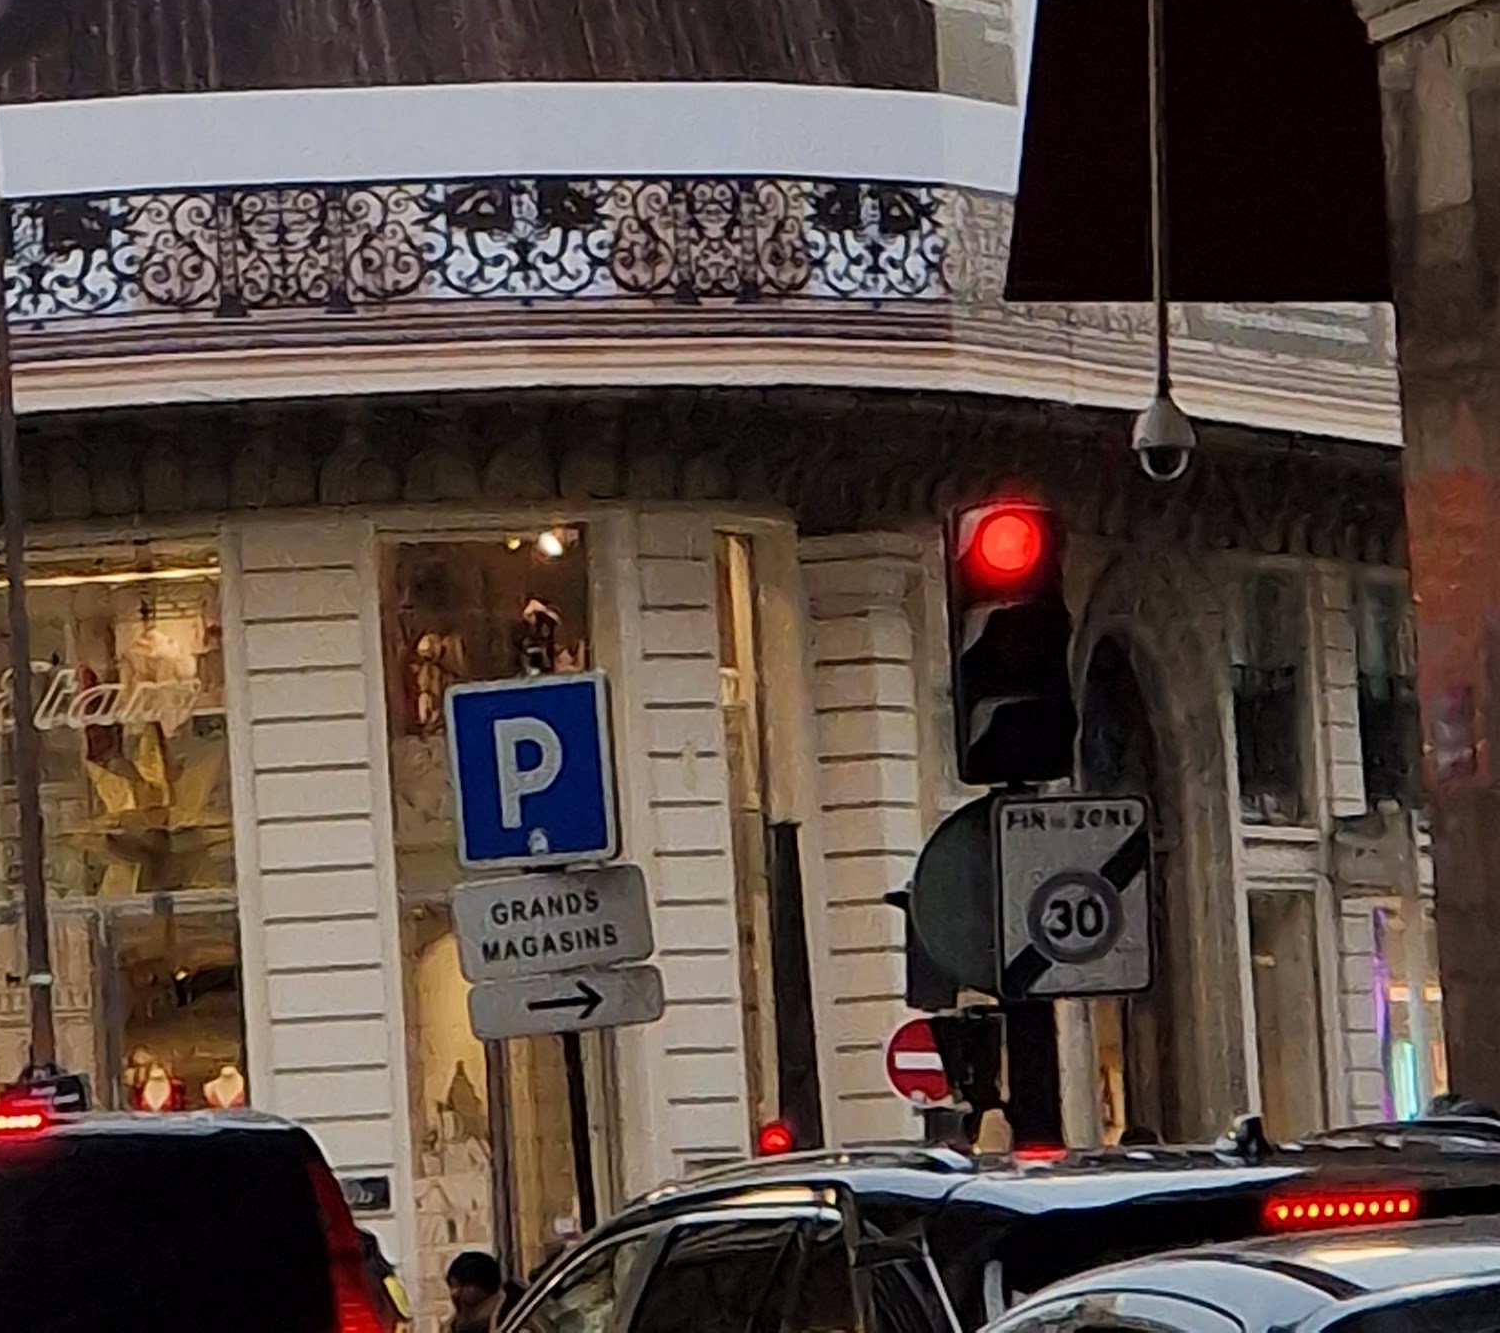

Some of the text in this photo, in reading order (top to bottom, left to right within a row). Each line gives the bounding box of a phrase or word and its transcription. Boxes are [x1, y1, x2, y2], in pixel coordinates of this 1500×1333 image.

[493, 716, 563, 829] P
[490, 888, 599, 925] GRANDS
[1047, 895, 1104, 940] 30
[482, 923, 618, 963] MAGASINS
